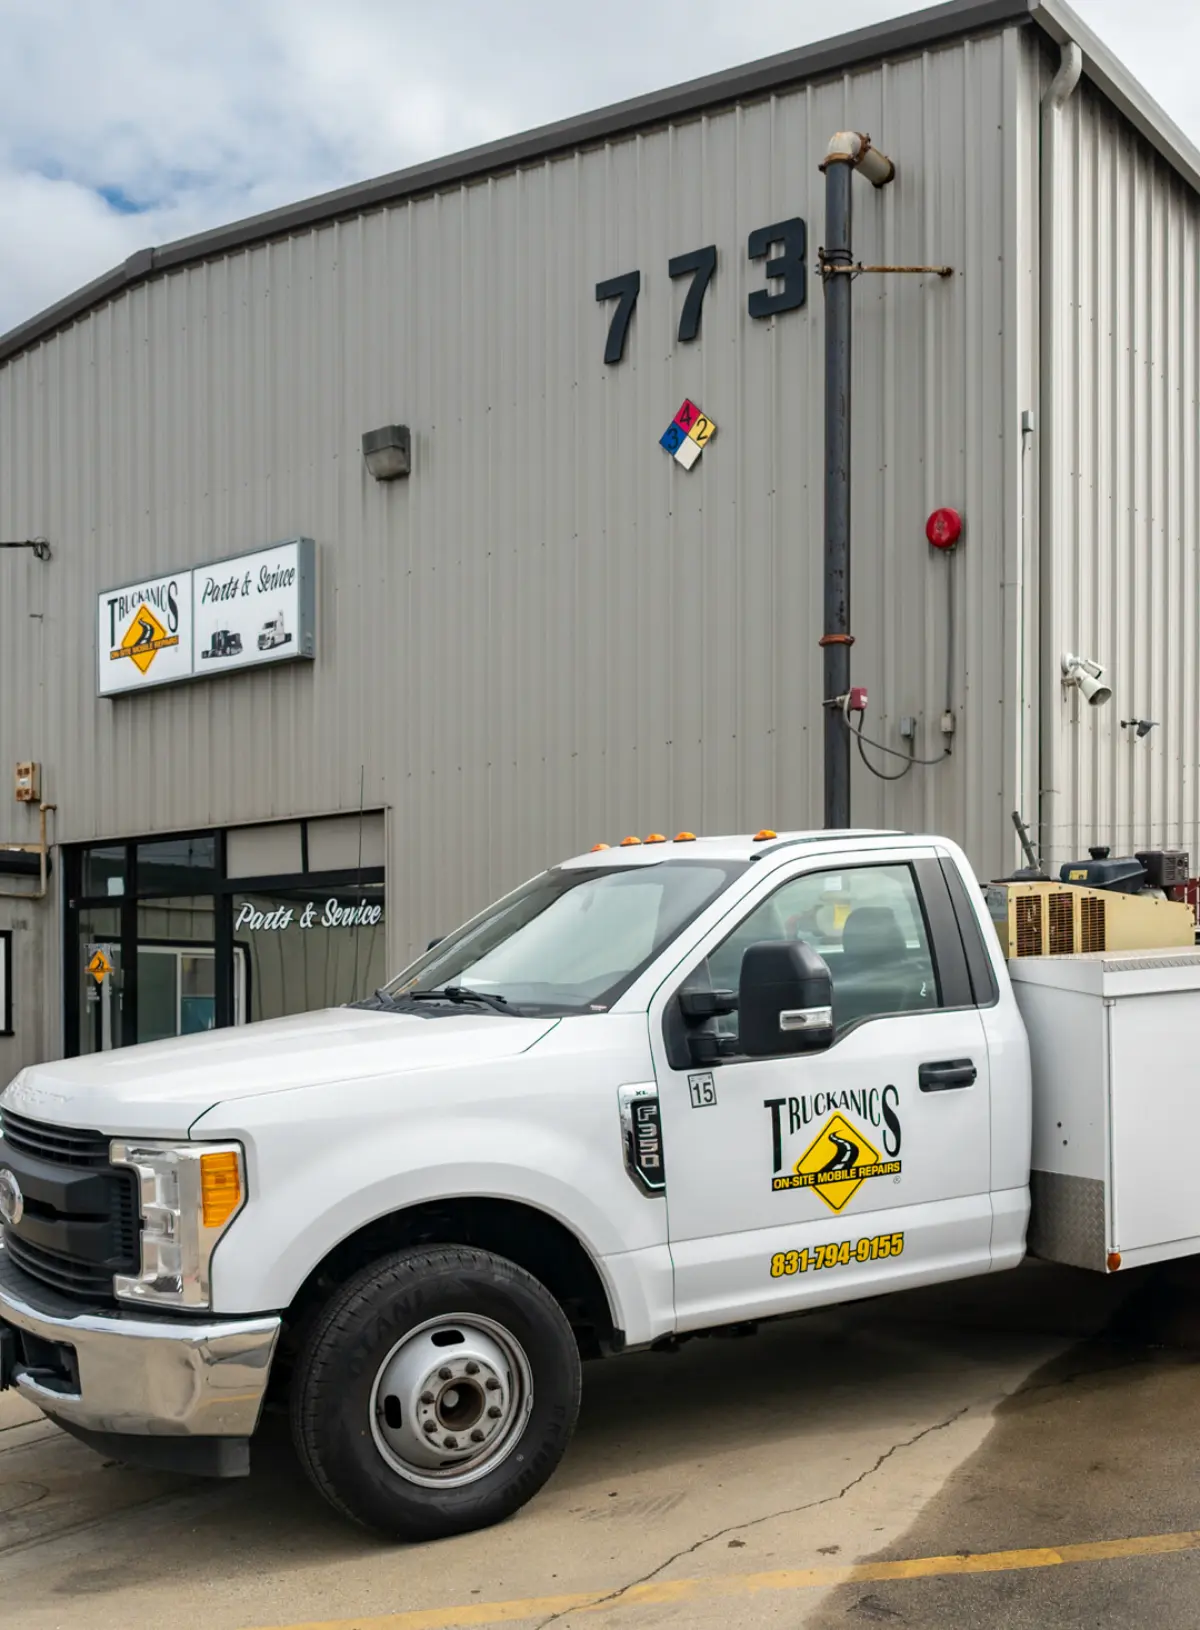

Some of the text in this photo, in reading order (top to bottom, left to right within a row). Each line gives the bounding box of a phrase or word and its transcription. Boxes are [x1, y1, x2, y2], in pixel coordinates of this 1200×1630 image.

[680, 404, 692, 426] 4
[696, 418, 708, 441] 2
[667, 428, 678, 450] 3
[201, 563, 296, 605] Parts & Service
[107, 580, 179, 649] TRUCKANICS
[235, 897, 382, 931] Parts & Service
[693, 1081, 713, 1104] 15
[637, 1104, 660, 1168] F350
[763, 1084, 902, 1174] TRUCKANICS
[773, 1161, 901, 1190] ON-SITE MOBILE REPAIRS
[770, 1231, 904, 1278] 831-794-9155
